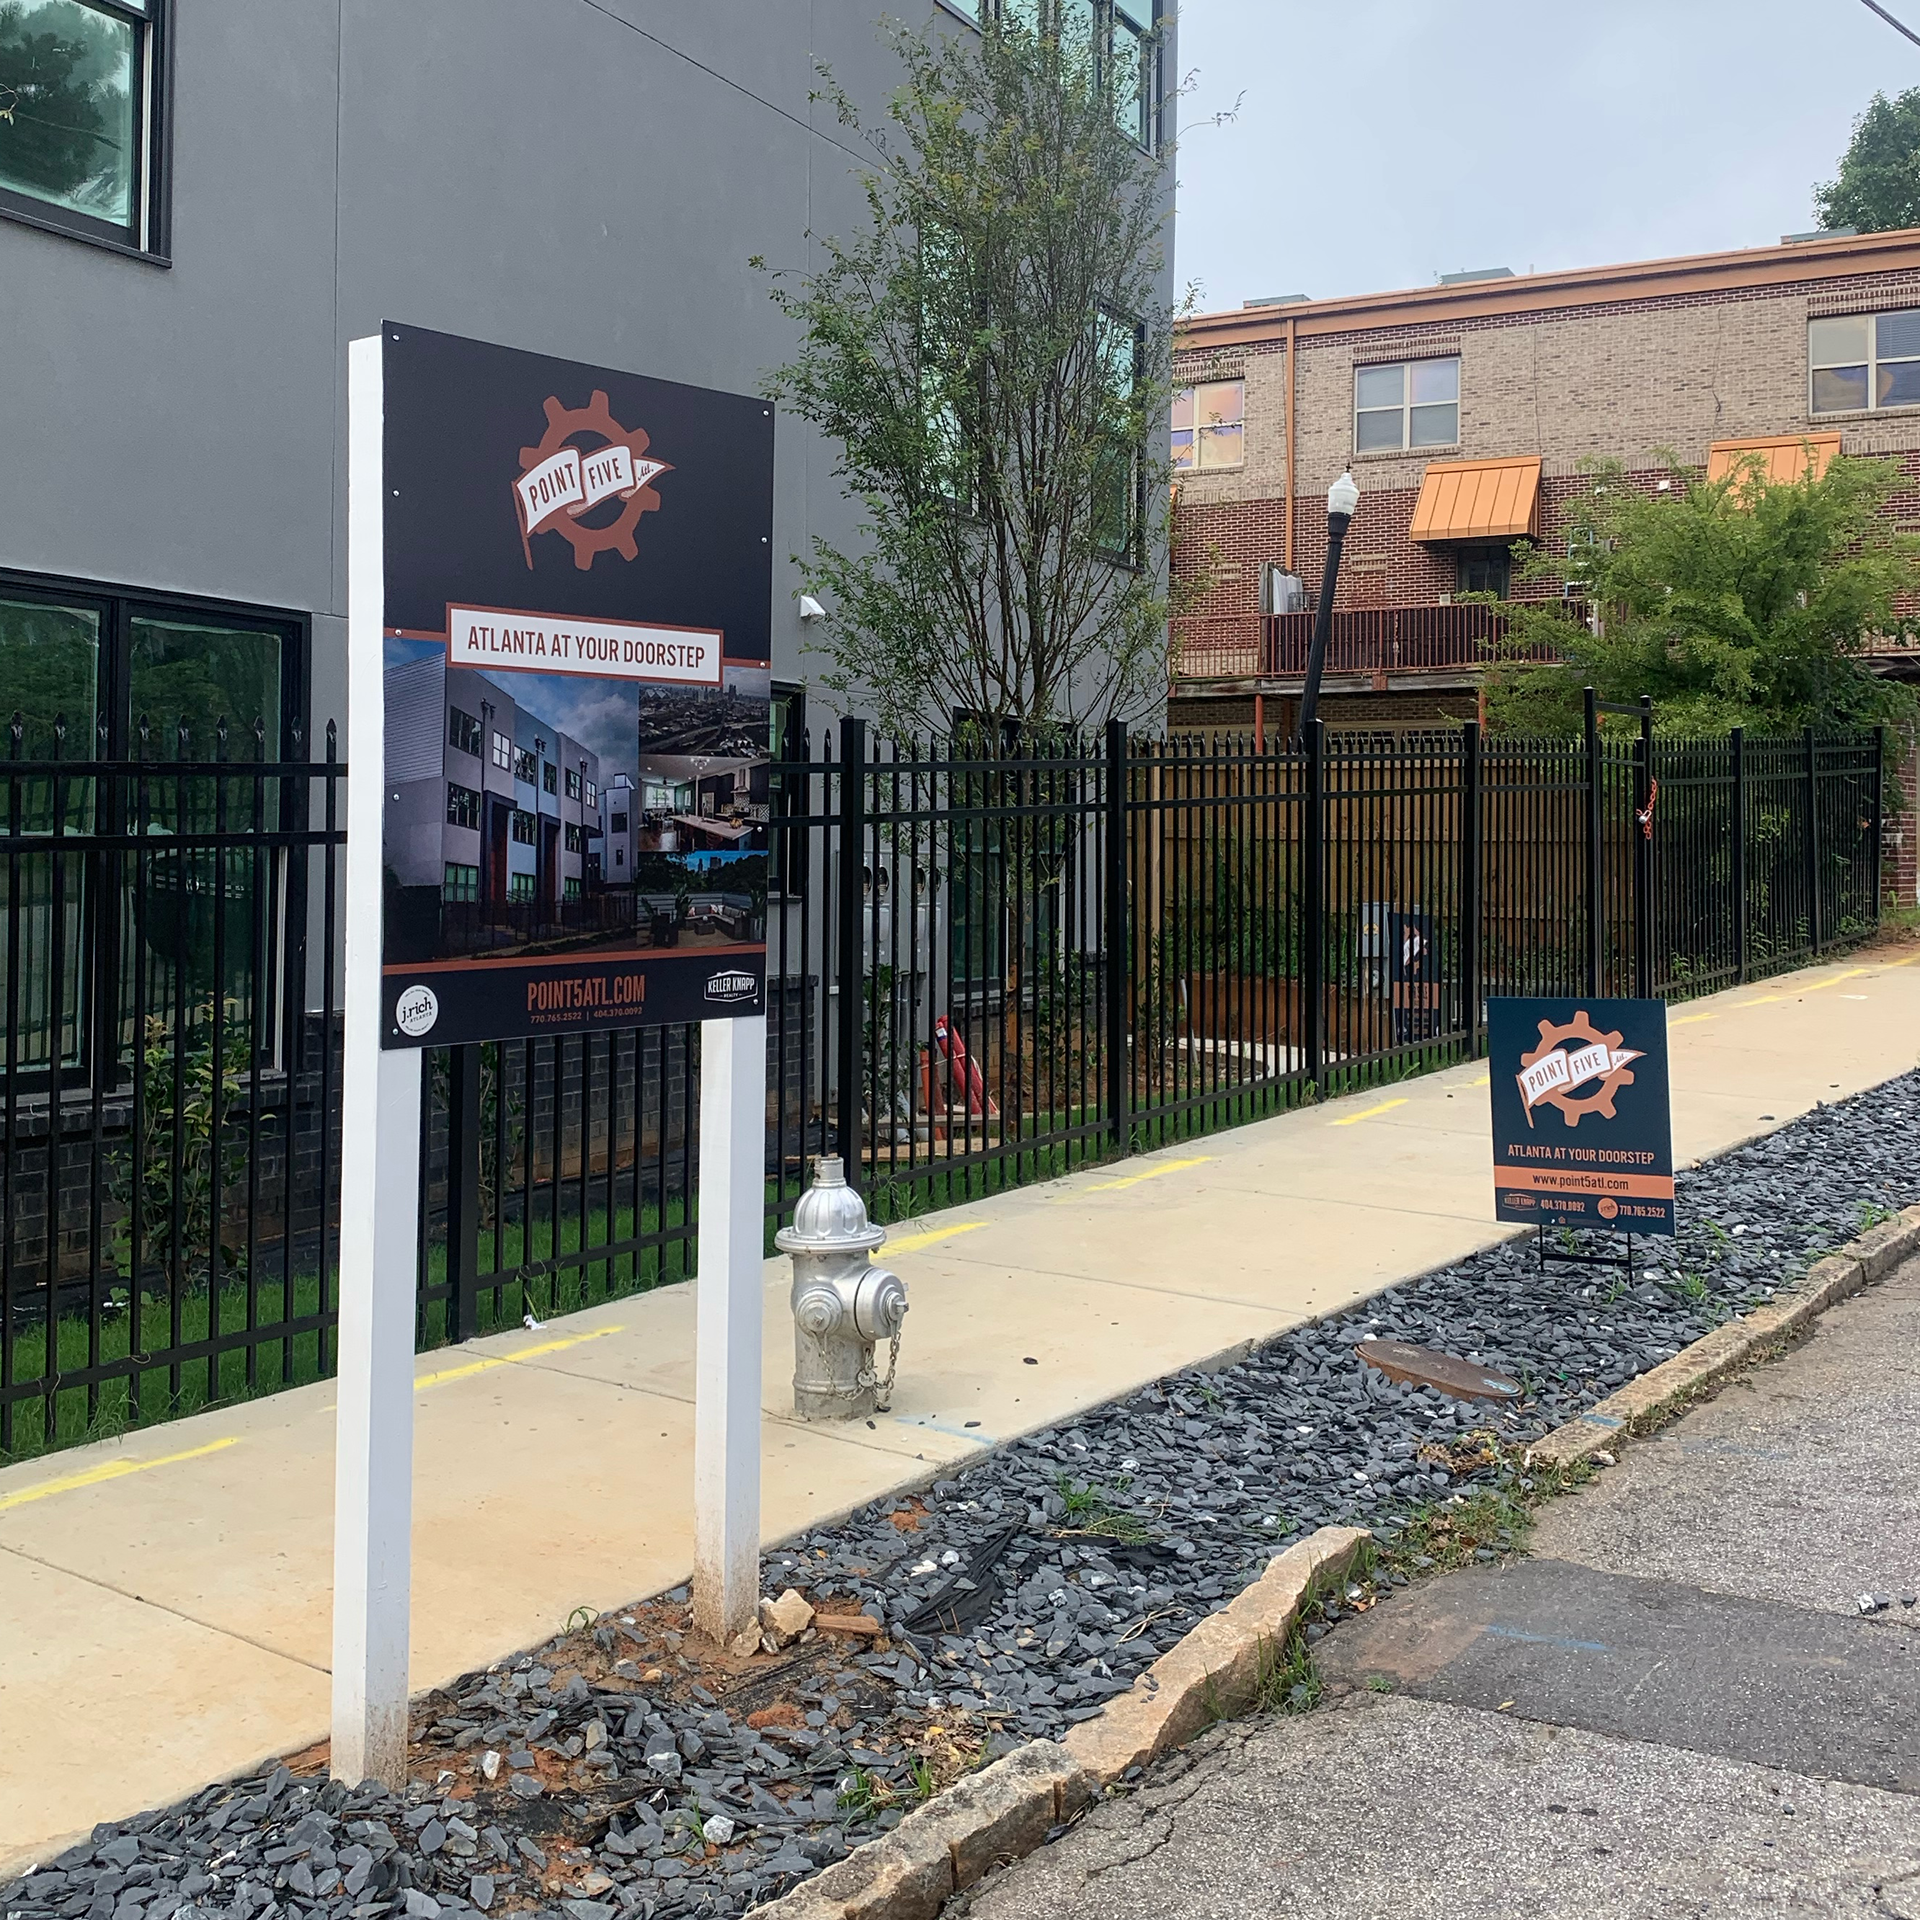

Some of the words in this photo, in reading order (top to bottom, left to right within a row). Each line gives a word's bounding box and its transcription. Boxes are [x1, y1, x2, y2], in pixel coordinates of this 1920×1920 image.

[528, 463, 576, 512] POINT
[587, 457, 623, 490] FIVE
[467, 625, 547, 657] ATLANTA
[550, 633, 571, 658] AT
[575, 635, 619, 662] YOUR
[623, 640, 705, 669] DOORSTEP
[527, 974, 646, 1011] POINT5ATL.COM
[707, 977, 732, 993] KELLER
[732, 976, 755, 991] KNAPP
[401, 996, 433, 1024] j.rich
[410, 1011, 433, 1023] ATLANTA
[530, 1012, 582, 1024] 770.765.2522
[593, 1007, 643, 1018] 404.370.0092
[1528, 1060, 1565, 1092] POINT
[1573, 1052, 1602, 1075] FIVE
[1507, 1144, 1552, 1159] ATLANTA
[1554, 1147, 1567, 1160] AT
[1568, 1148, 1597, 1162] YOUR
[1598, 1149, 1655, 1165] DOORSTEP
[1532, 1174, 1629, 1190] www.point5atl.com
[1540, 1198, 1586, 1213] 404.370.0092
[1619, 1204, 1666, 1218] 770.765.2522
